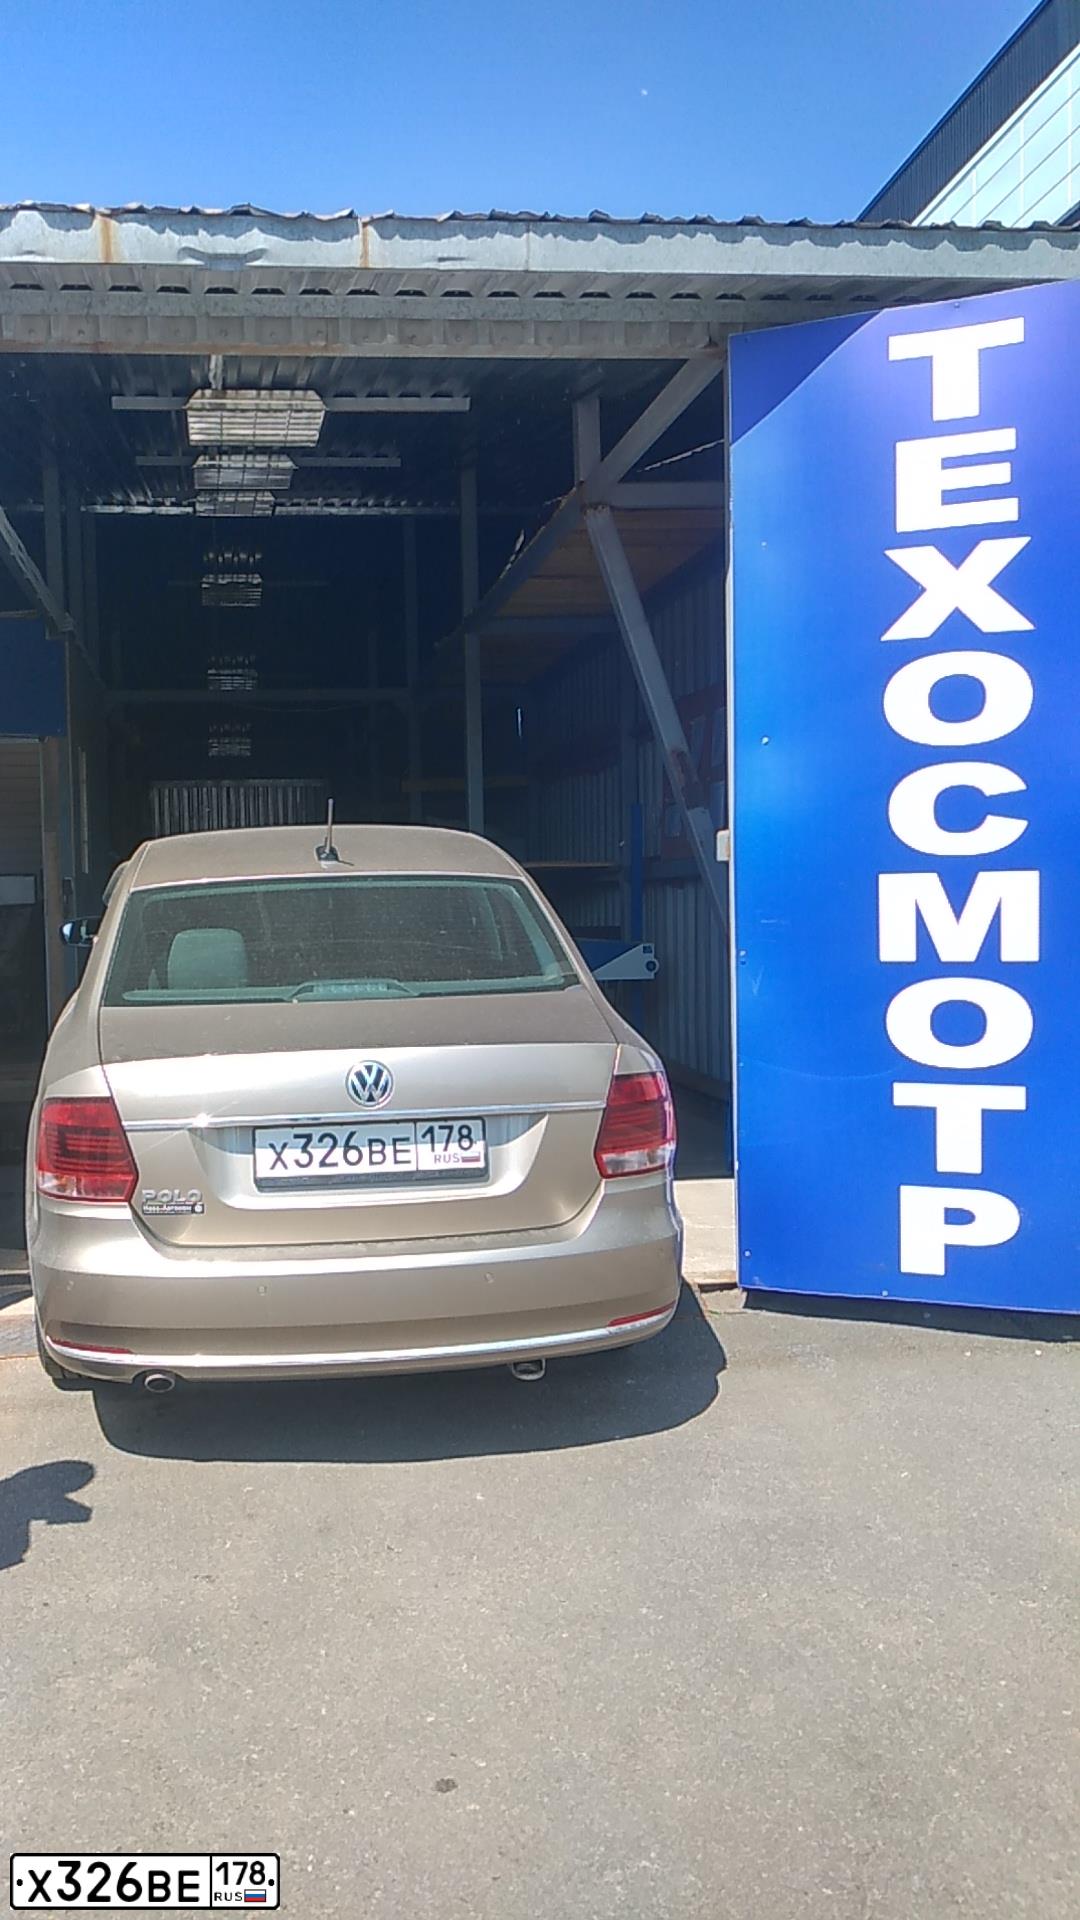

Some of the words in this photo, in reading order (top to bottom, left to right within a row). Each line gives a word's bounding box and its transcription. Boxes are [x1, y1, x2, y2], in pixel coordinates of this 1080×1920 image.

[879, 315, 1040, 1277] ТЕХОСМОТР
[421, 1124, 473, 1153] 178
[433, 1153, 460, 1164] RUS
[141, 1189, 203, 1203] POLO
